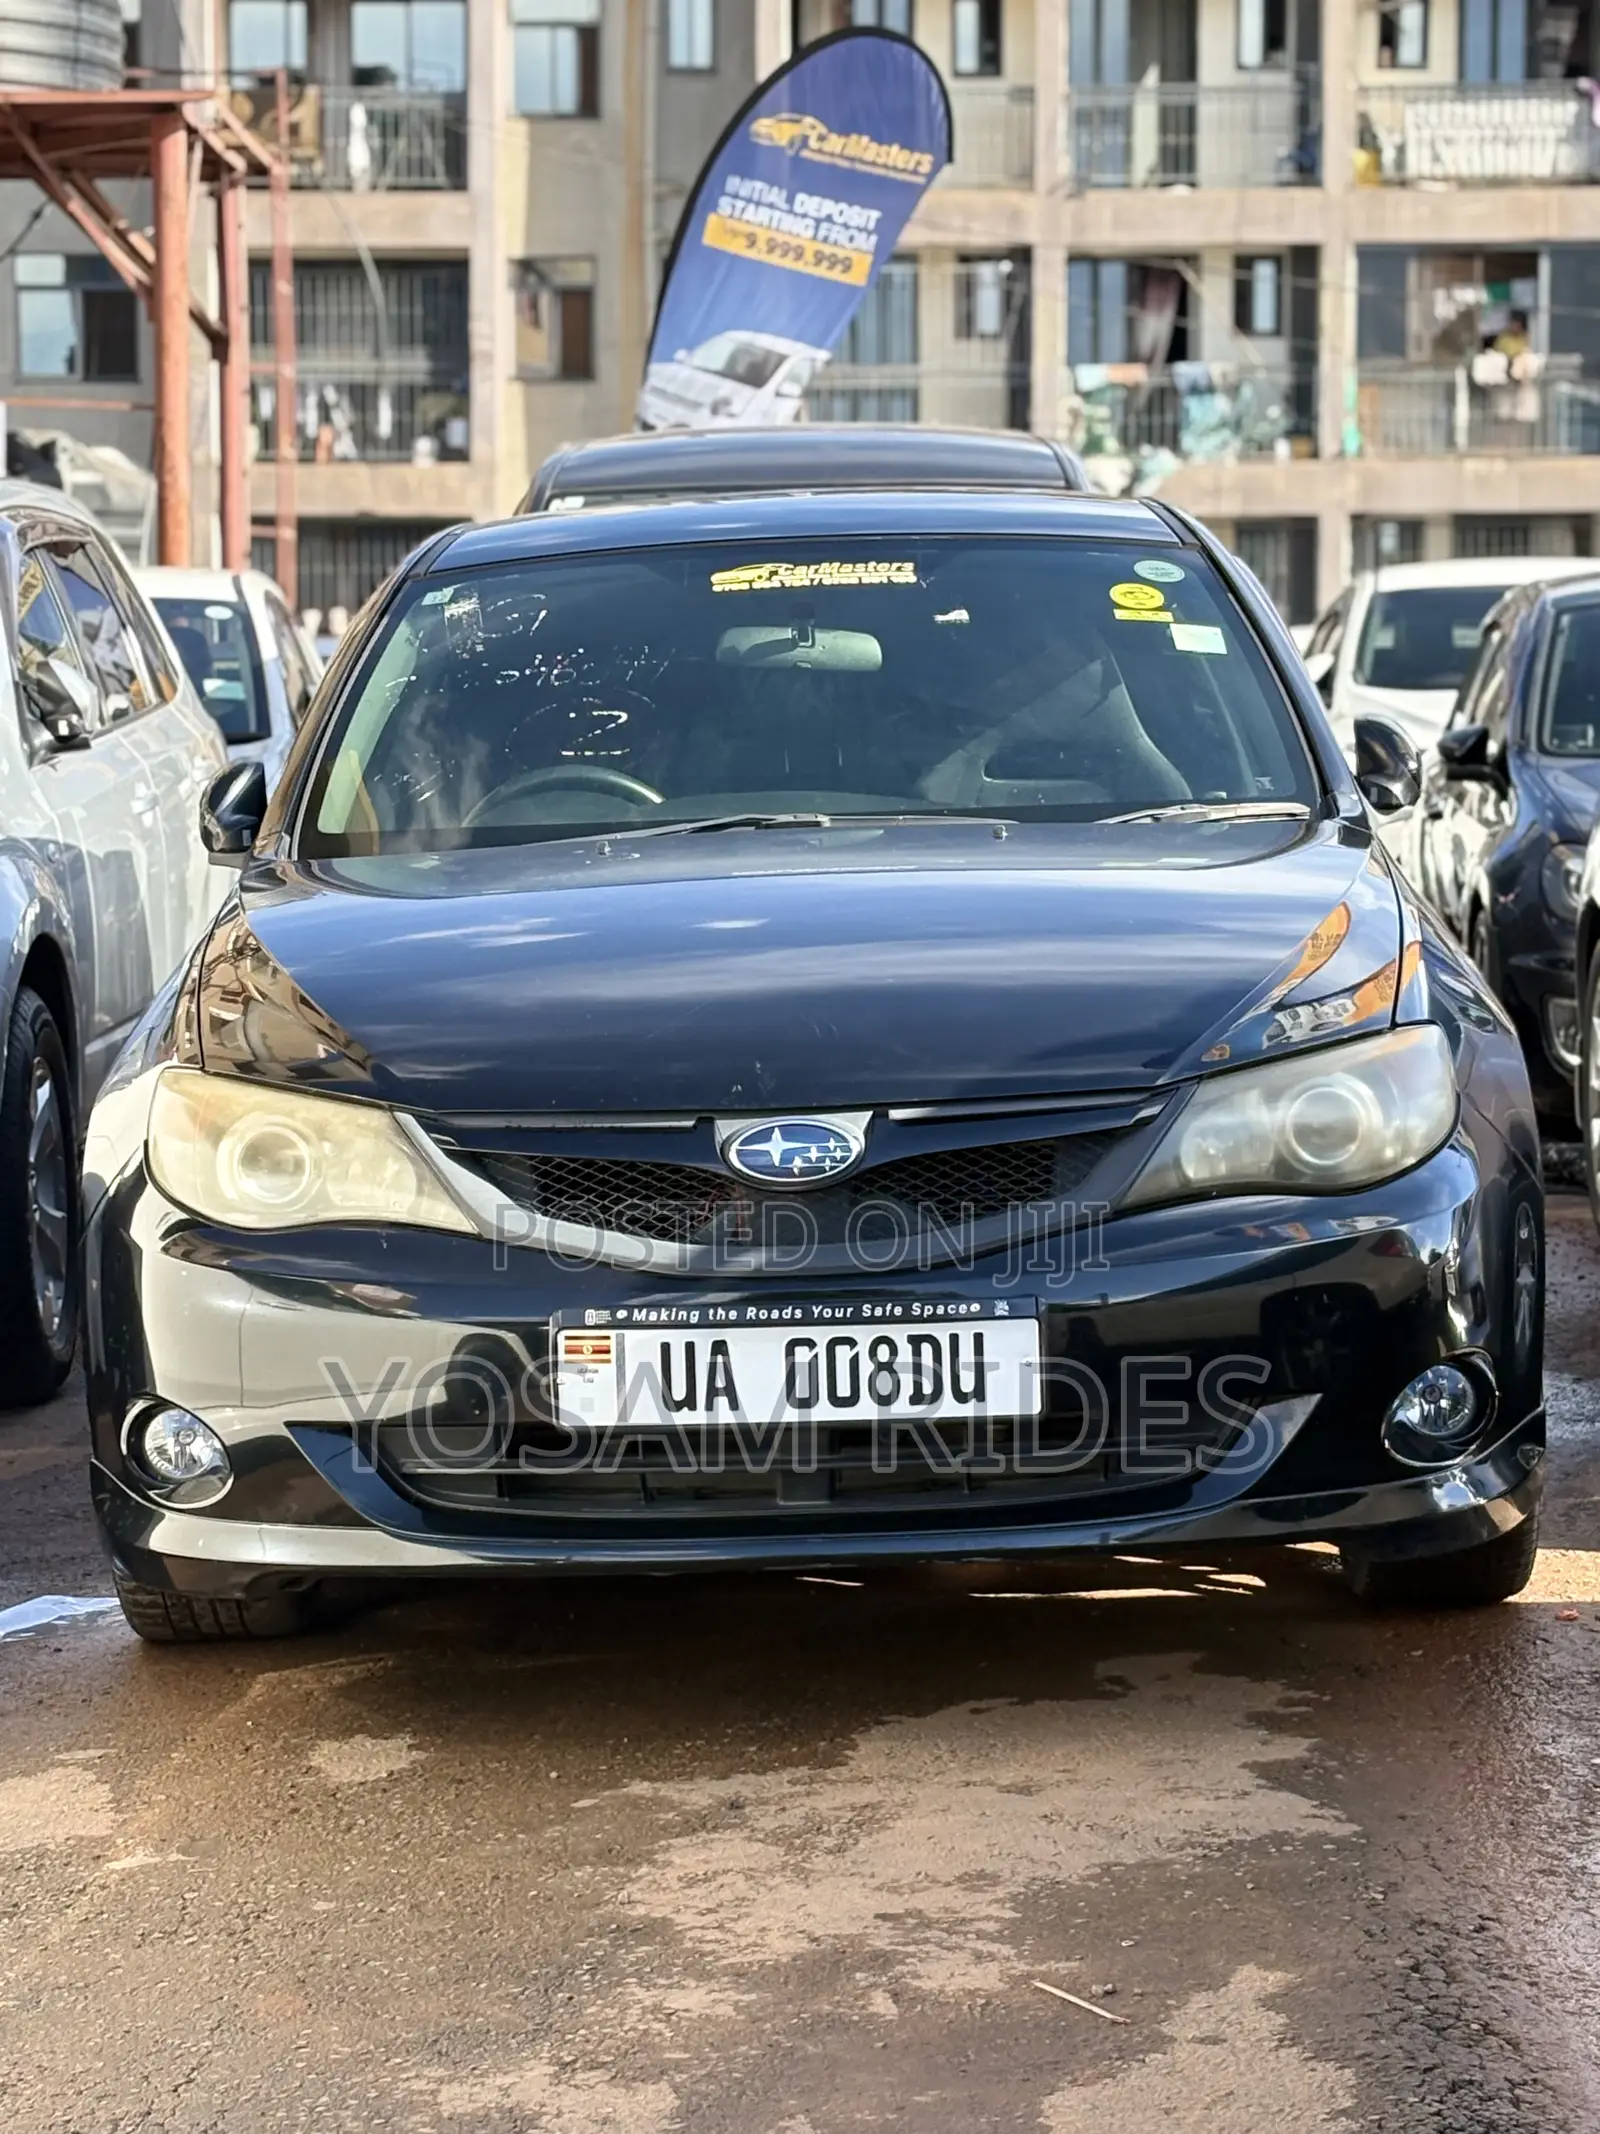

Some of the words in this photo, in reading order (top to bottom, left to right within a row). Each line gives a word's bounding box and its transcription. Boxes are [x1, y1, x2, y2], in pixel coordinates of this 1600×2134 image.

[807, 130, 935, 174] CarMasters
[717, 195, 816, 239] STARTING
[817, 221, 879, 253] FROM
[724, 174, 791, 210] INITIAL
[793, 192, 882, 230] DEPOSIT
[778, 561, 915, 577] CarMasters
[632, 1307, 700, 1323] Making
[708, 1307, 739, 1321] the
[746, 1304, 802, 1320] Roads
[811, 1304, 854, 1319] Your
[861, 1303, 903, 1317] Safe
[910, 1302, 968, 1318] Space
[659, 1340, 739, 1413] UA
